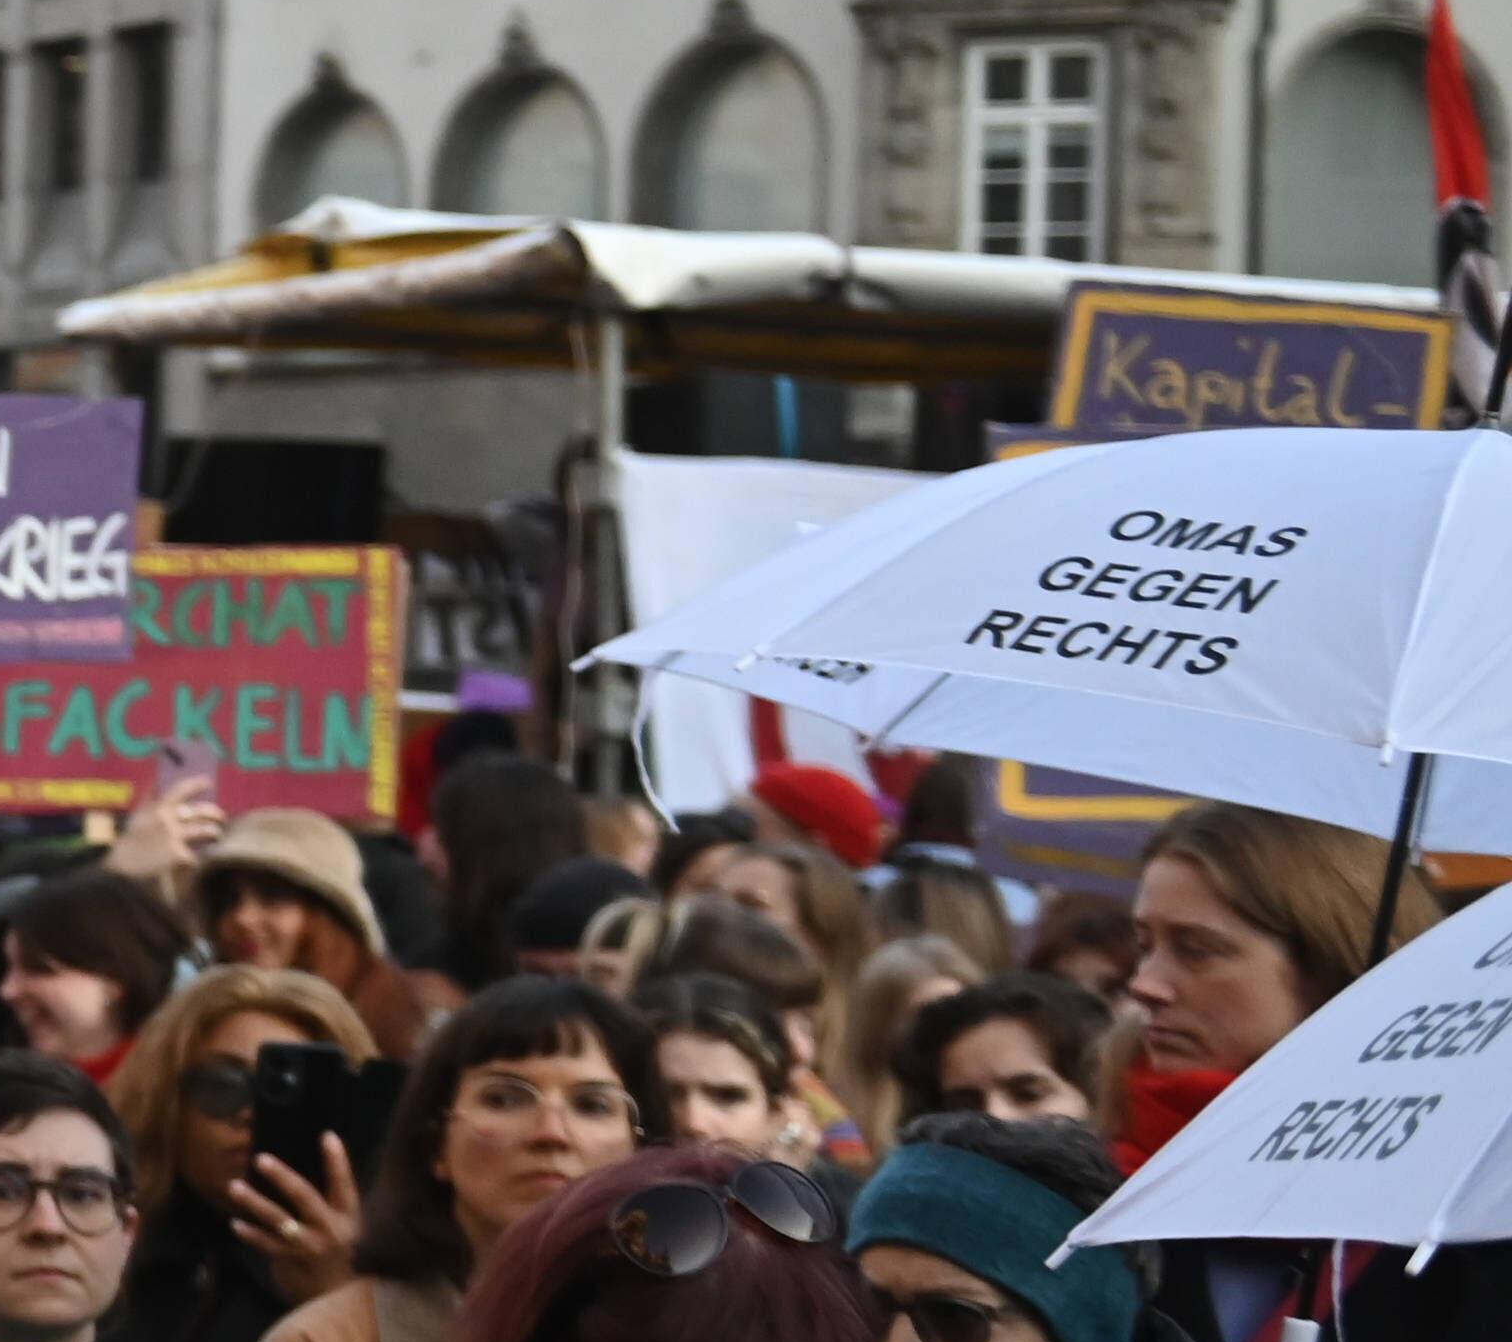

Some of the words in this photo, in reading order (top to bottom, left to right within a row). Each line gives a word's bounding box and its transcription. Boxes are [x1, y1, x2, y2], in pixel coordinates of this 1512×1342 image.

[1108, 509, 1307, 558] OMAS
[1037, 555, 1280, 614] GEGEN
[964, 609, 1240, 676] RECHTS
[1249, 1093, 1442, 1162] RECHTS
